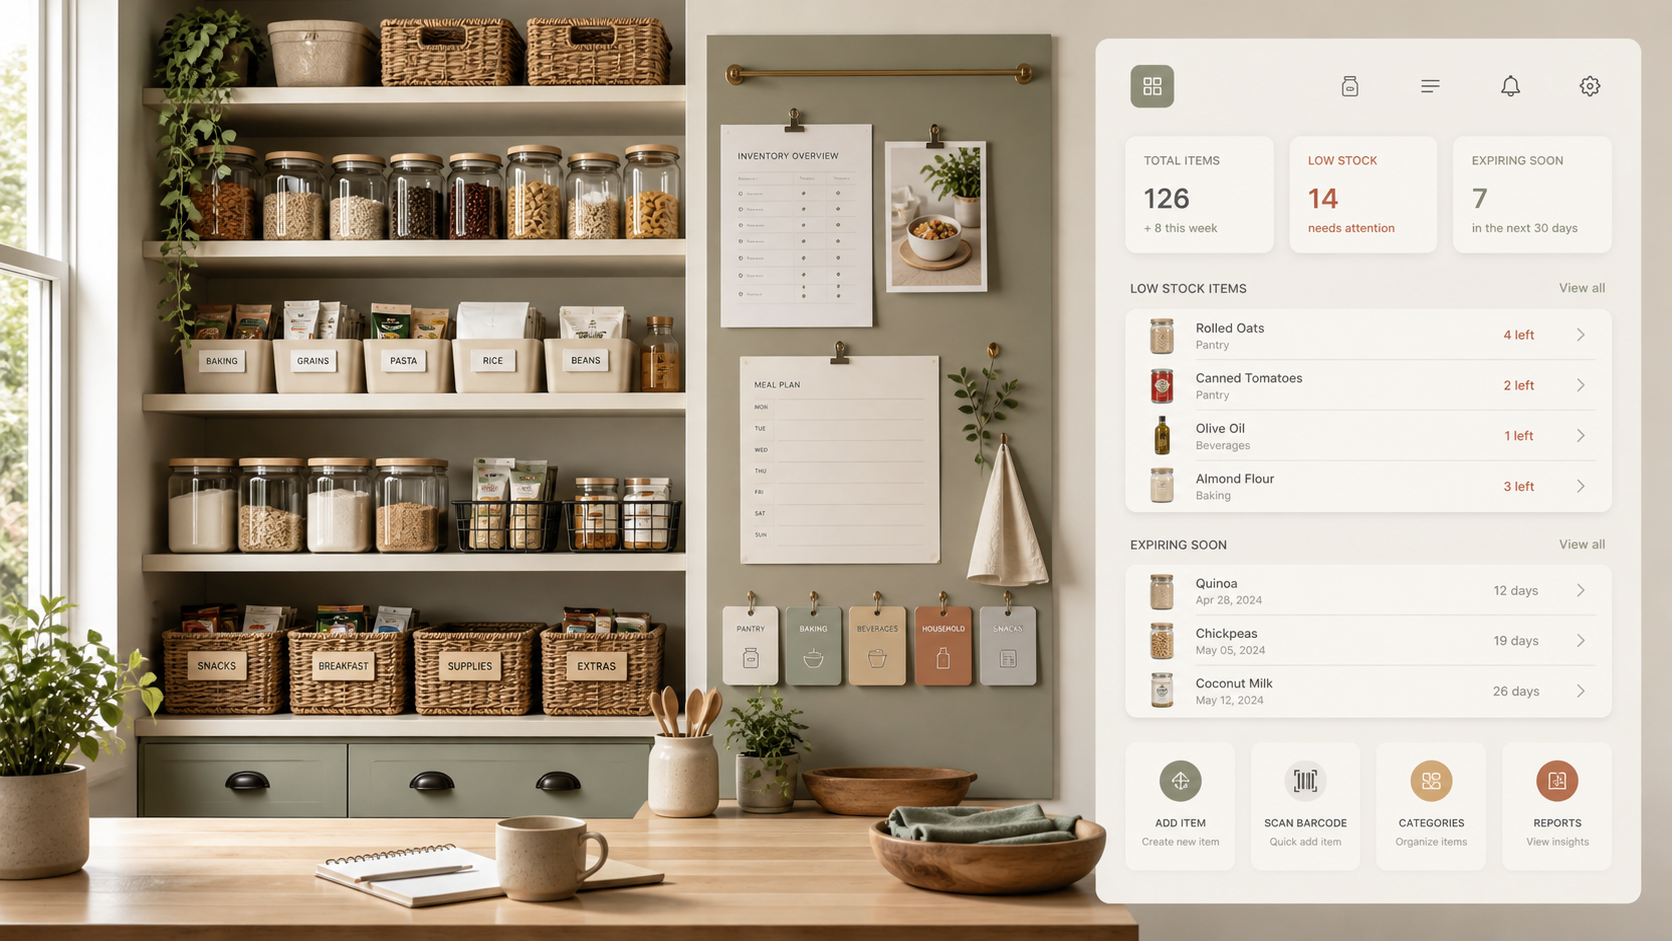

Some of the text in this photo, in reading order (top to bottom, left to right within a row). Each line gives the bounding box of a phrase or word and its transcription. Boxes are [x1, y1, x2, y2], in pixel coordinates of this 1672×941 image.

[738, 151, 839, 160] INVENTORY OVERVIEW
[206, 357, 238, 366] BAKING
[297, 356, 329, 365] GRAINS
[390, 356, 417, 365] PASTA
[483, 356, 503, 365] RICE
[571, 356, 601, 365] BEANS
[754, 381, 800, 389] MEAL PLAN
[755, 467, 767, 475] THU
[737, 625, 765, 633] PANTRY
[799, 625, 828, 633] BAKING
[922, 625, 965, 633] HOUSEHOLD
[197, 661, 236, 671] SNACKS
[319, 661, 369, 671] BREAKFAST
[448, 661, 492, 671] SUPPLIES
[578, 661, 616, 671] EXTRAS
